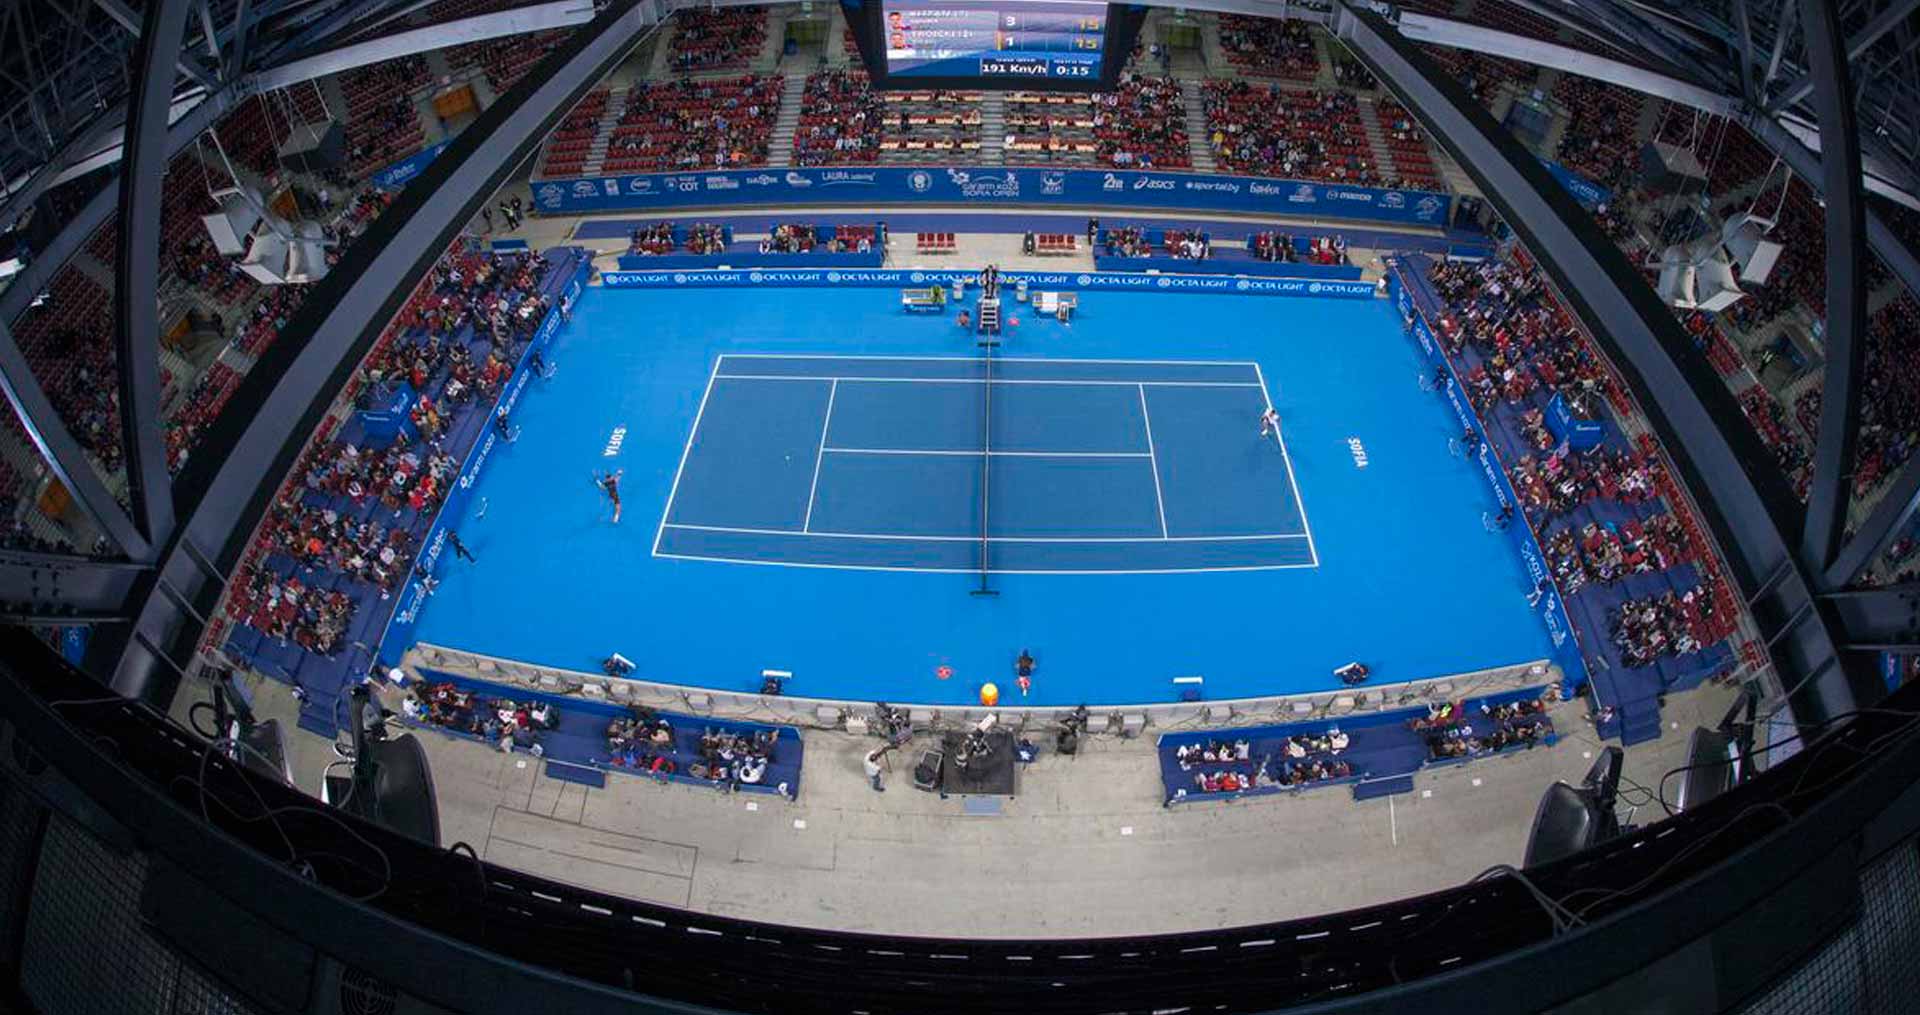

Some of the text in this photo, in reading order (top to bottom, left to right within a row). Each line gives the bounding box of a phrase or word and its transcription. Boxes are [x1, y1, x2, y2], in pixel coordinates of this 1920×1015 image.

[1006, 16, 1016, 26] 3
[1076, 39, 1098, 49] 15
[982, 64, 1047, 74] 191 Km/h
[1056, 66, 1089, 76] 0:15
[822, 171, 849, 181] LAURA
[618, 275, 643, 283] OCTA
[687, 273, 740, 282] OCTA LIGHT
[763, 273, 820, 281] OCTA LIGHT
[842, 273, 900, 281] OCTA LIGHT
[925, 273, 951, 281] OCTA
[1092, 277, 1151, 286] OCTA LIGHT
[1171, 279, 1228, 288] OCTA LIGHT
[1251, 282, 1303, 291] OCTA LIGHT
[1322, 285, 1373, 294] OCTA LIGHT
[604, 427, 627, 457] SOFIA
[1348, 438, 1369, 467] SOFIA
